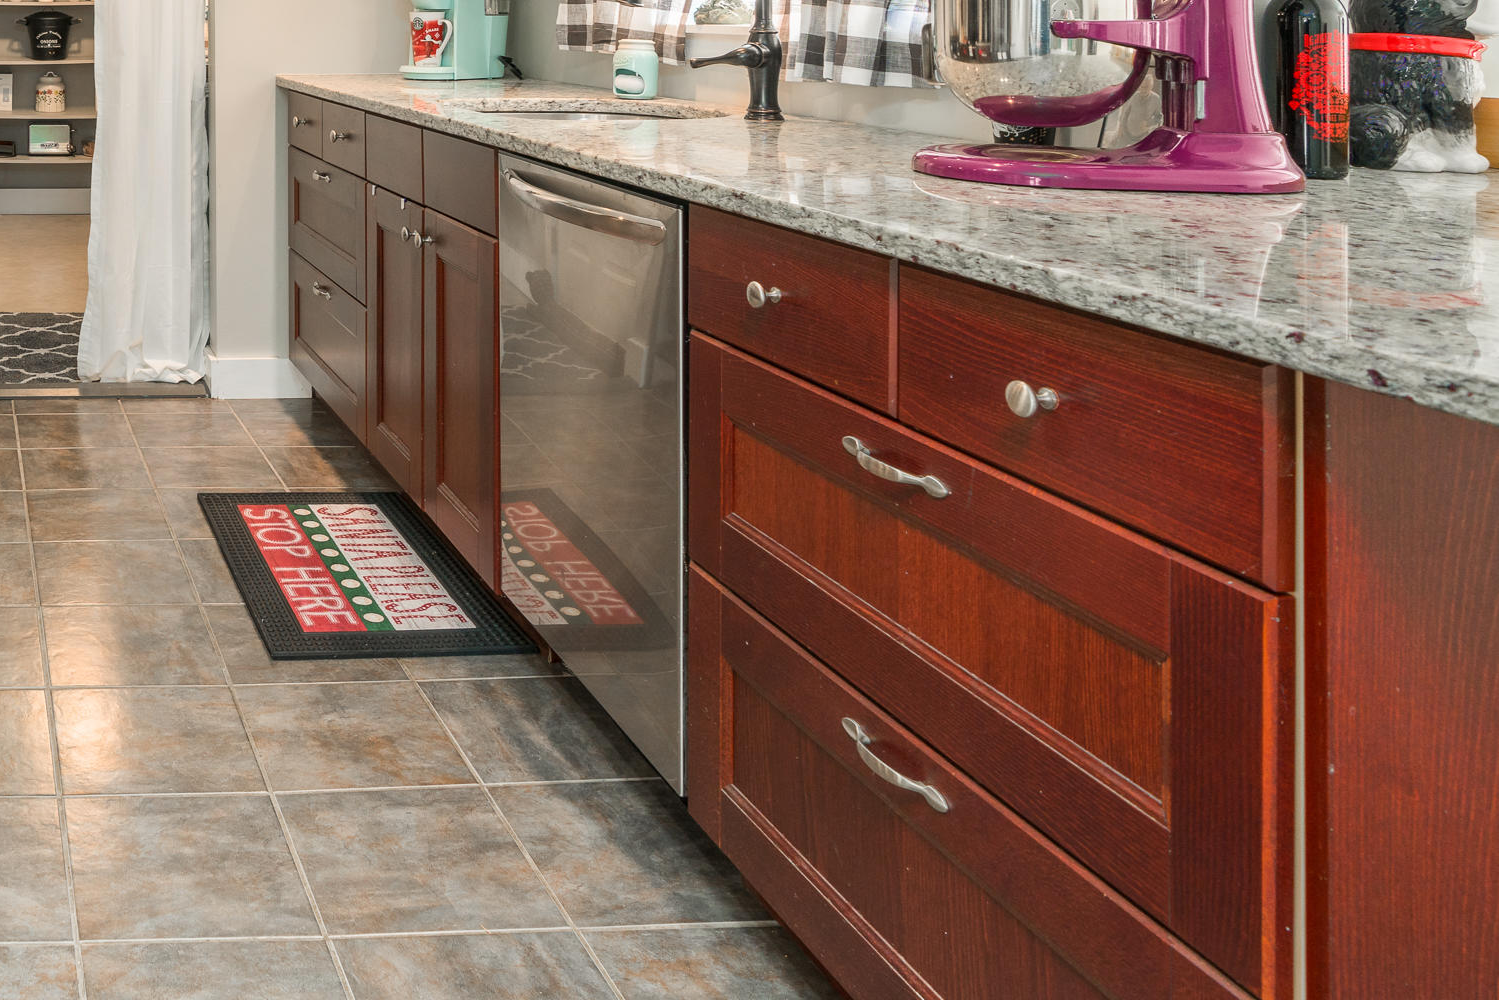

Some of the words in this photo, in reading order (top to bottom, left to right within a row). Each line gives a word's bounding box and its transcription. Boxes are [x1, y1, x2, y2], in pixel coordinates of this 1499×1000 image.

[243, 508, 312, 557] STOP
[316, 505, 415, 562] SANTA
[275, 566, 358, 626] HERE
[361, 563, 470, 626] PLEASE
